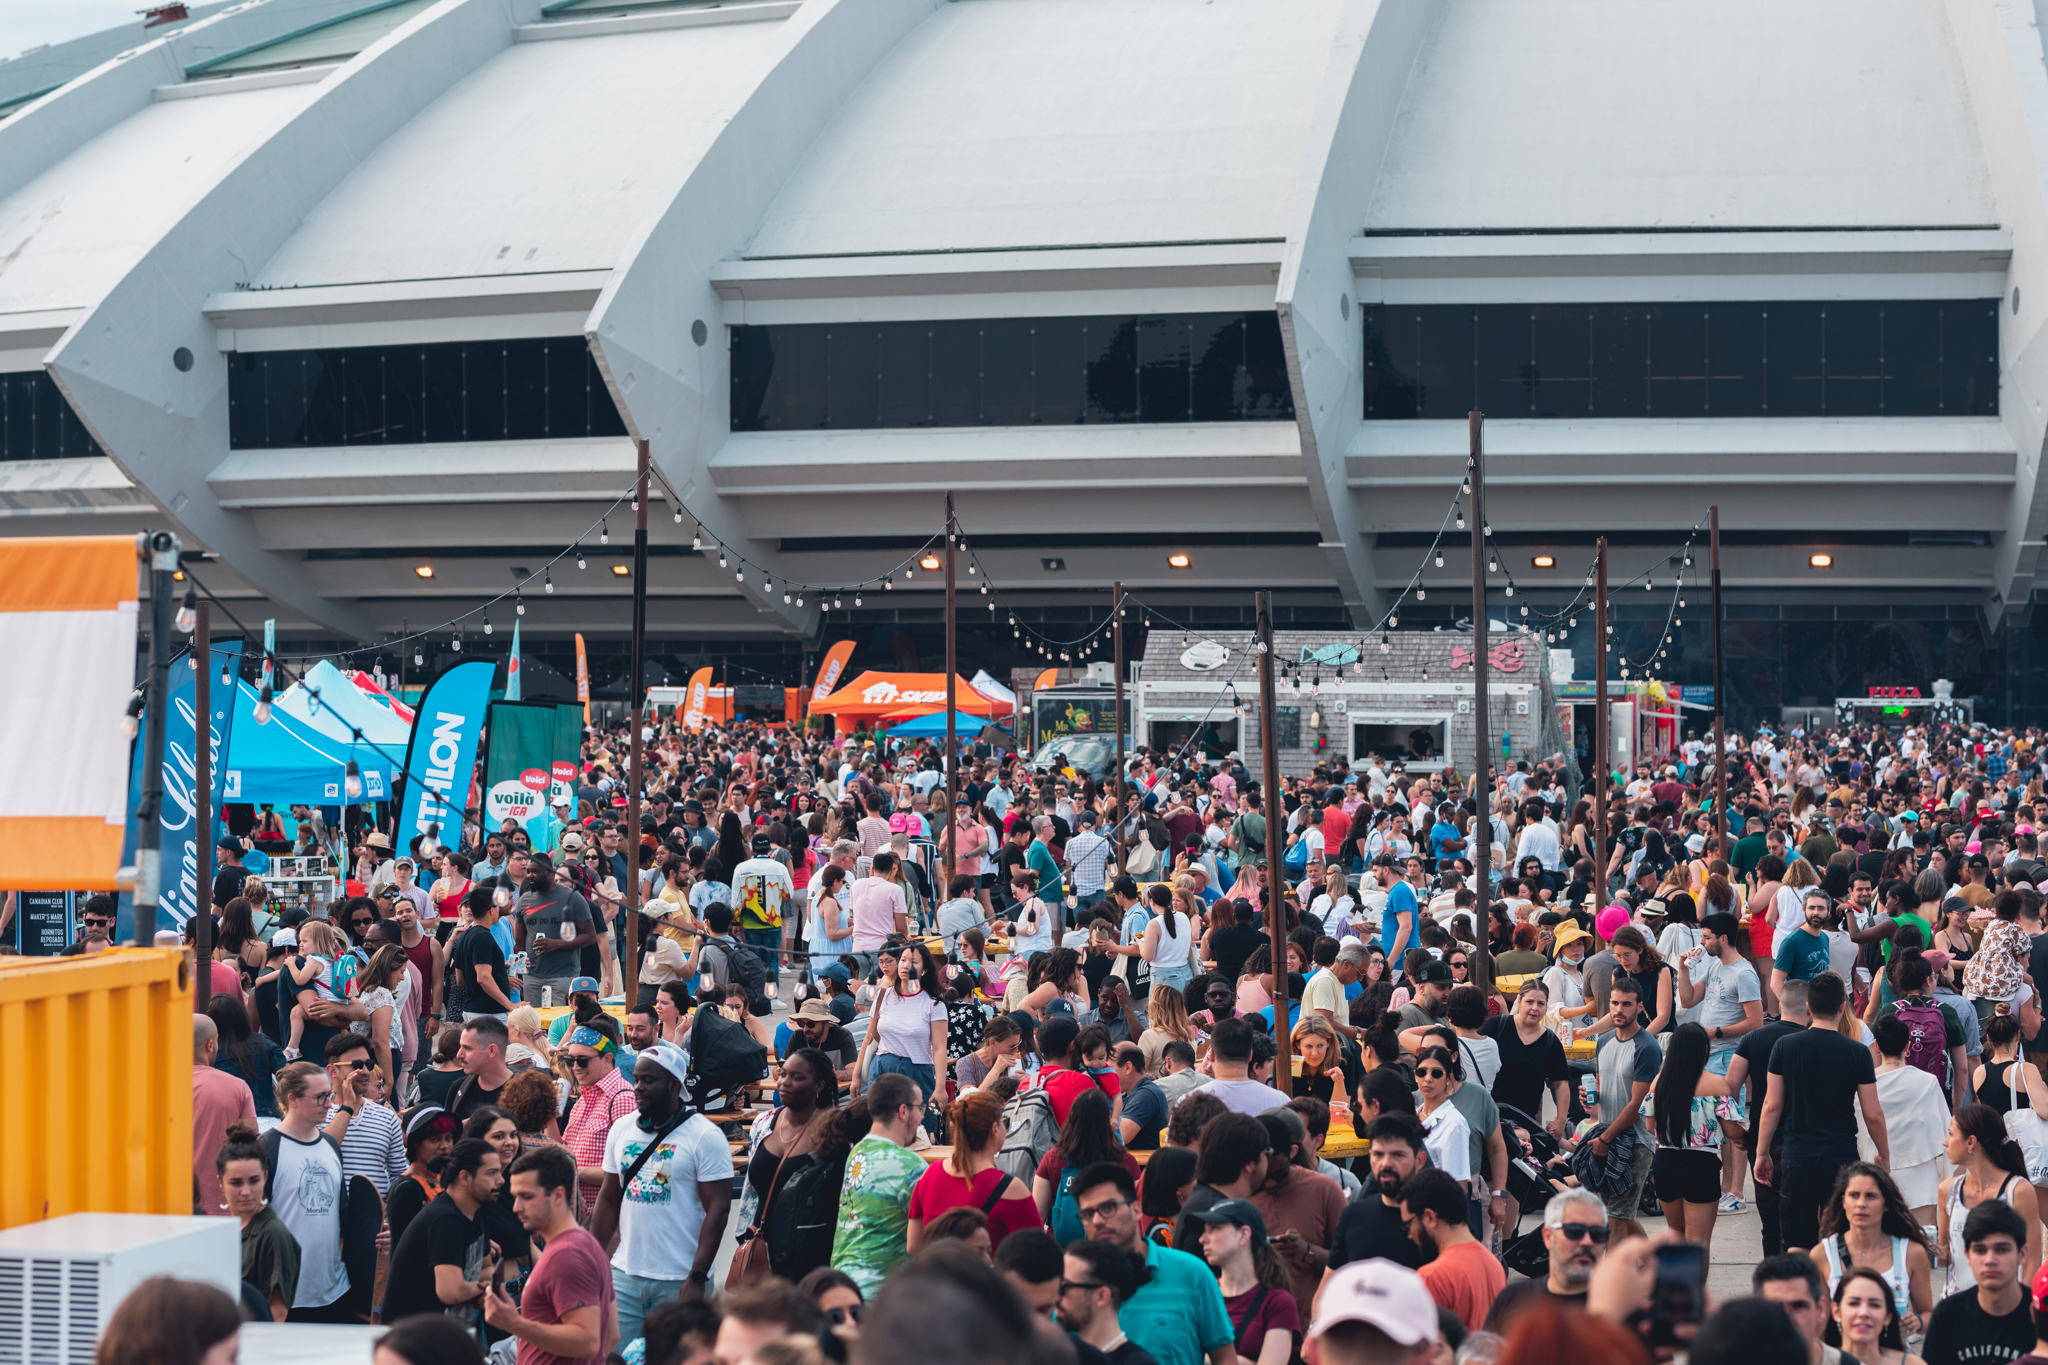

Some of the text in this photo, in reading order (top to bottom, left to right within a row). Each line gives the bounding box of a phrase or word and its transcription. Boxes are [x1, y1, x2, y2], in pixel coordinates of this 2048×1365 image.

[824, 659, 841, 687] SKIP
[896, 690, 948, 703] SKIP
[1868, 686, 1922, 698] PIZZA
[552, 767, 573, 776] Voici
[525, 775, 545, 784] Voici
[509, 806, 527, 816] IGA
[29, 897, 63, 905] CANADIAN CLUB
[540, 917, 549, 925] DO
[41, 928, 63, 936] HORNITOS
[628, 1180, 663, 1194] adidas
